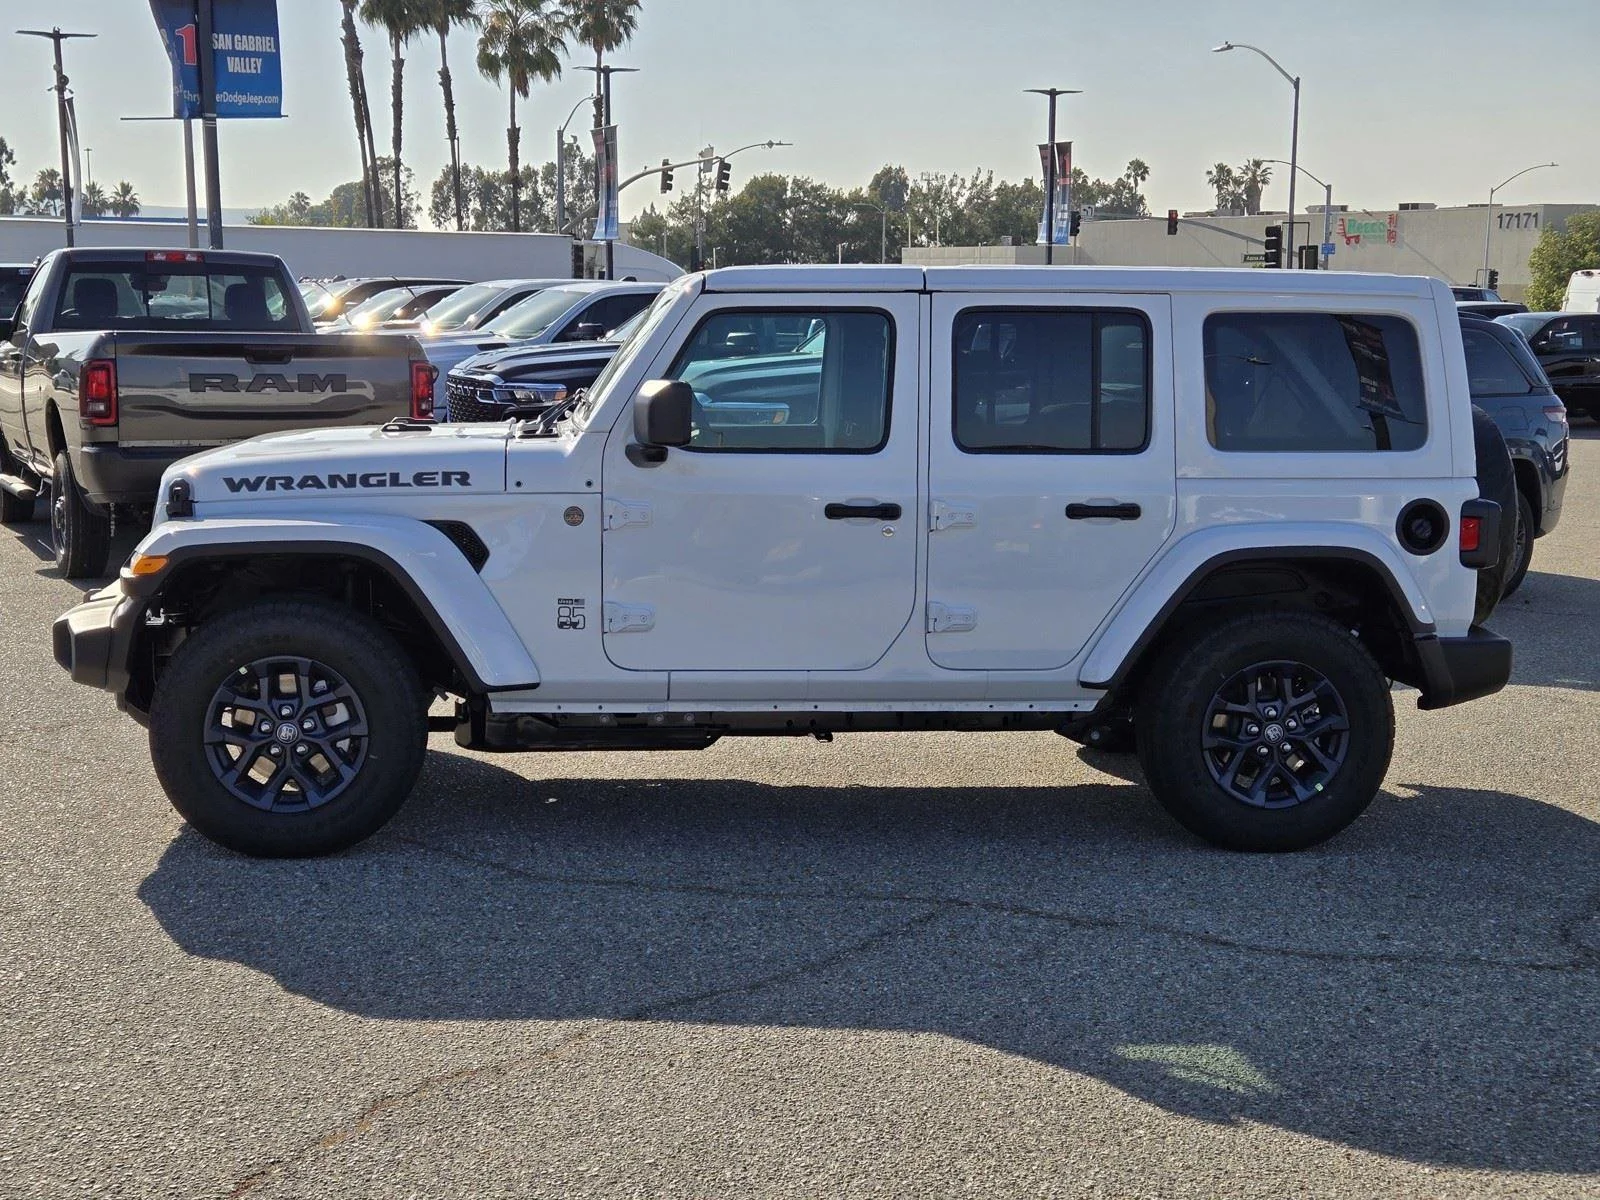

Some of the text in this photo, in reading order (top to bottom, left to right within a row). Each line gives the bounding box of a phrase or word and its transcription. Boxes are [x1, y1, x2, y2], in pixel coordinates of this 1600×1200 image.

[212, 33, 276, 53] SAN GABRIEL
[226, 56, 262, 74] VALLEY
[1497, 212, 1539, 229] 17171
[188, 373, 347, 393] RAM
[222, 471, 472, 493] WRANGLER
[557, 606, 586, 630] 85
